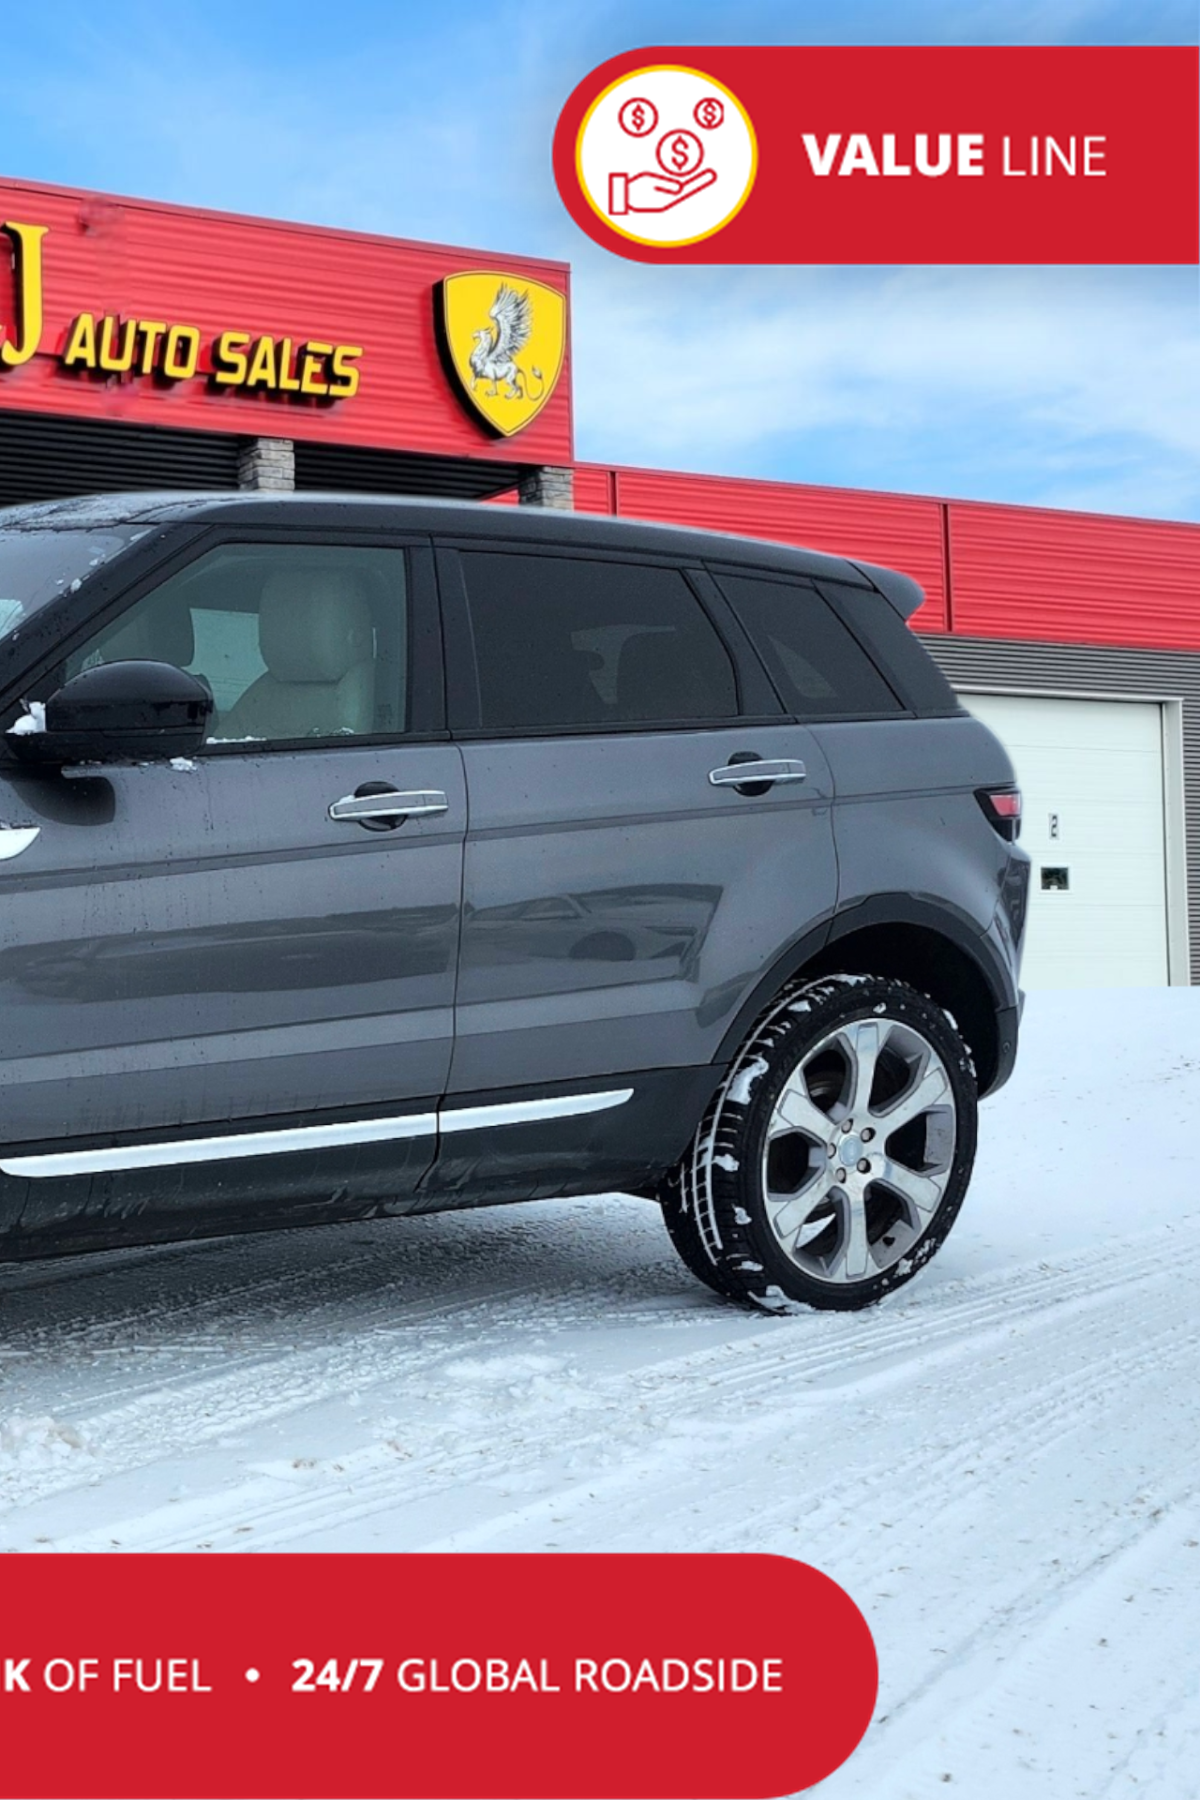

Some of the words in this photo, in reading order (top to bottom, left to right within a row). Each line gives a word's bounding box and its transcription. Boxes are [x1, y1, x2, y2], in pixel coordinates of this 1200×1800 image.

[64, 312, 201, 380] AUTO
[215, 330, 364, 398] SALES
[1050, 814, 1059, 838] 2
